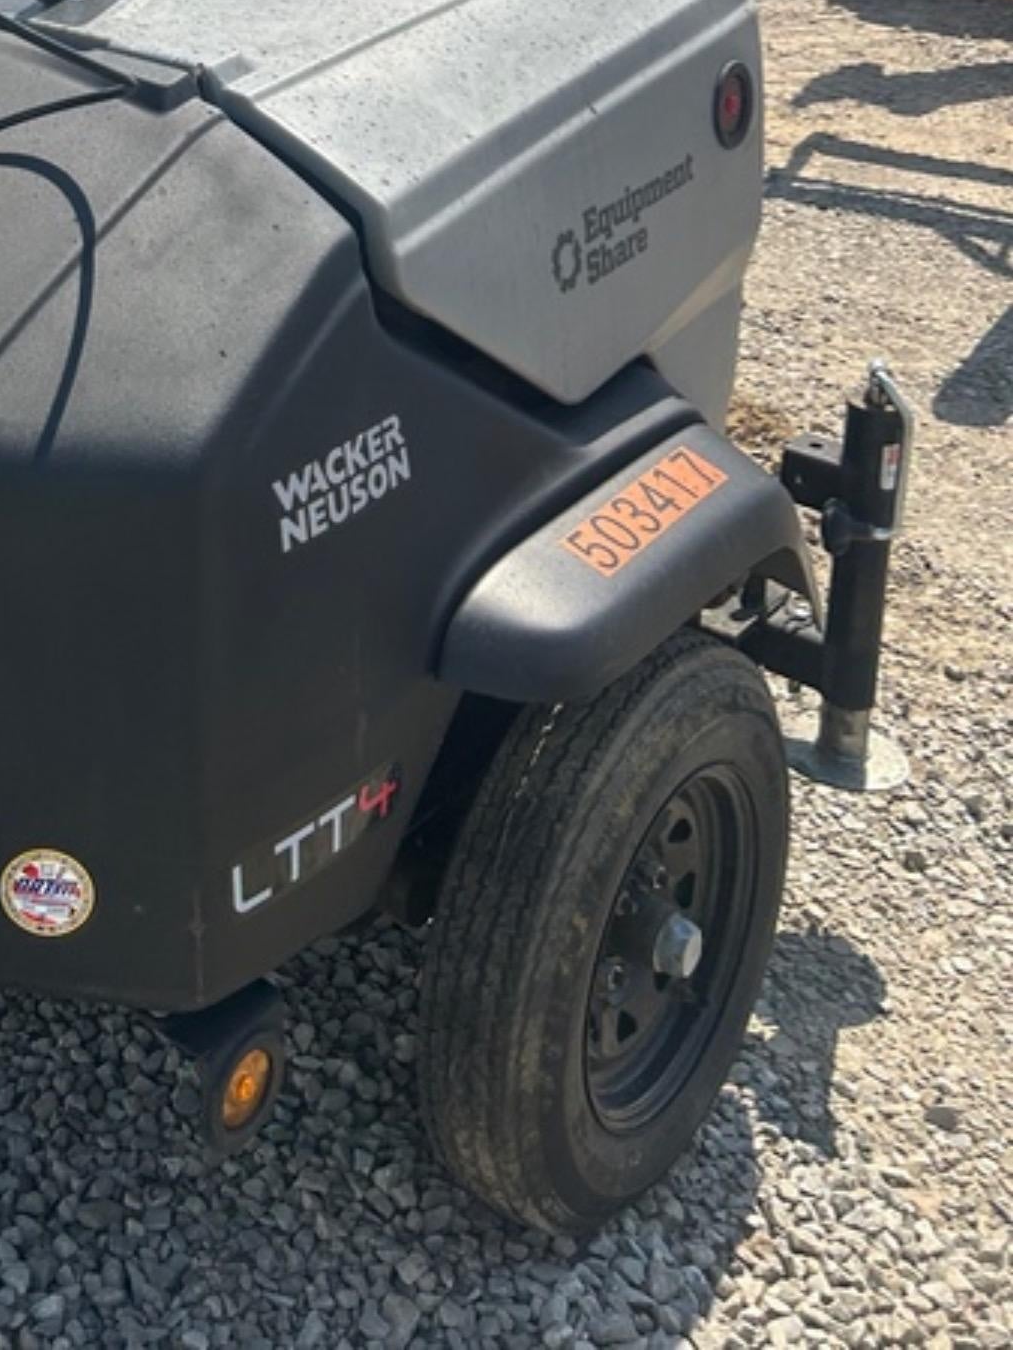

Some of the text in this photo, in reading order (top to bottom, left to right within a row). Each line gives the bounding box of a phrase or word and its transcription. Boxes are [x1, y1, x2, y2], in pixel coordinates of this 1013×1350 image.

[582, 153, 694, 244] Equipment
[586, 227, 648, 285] Share
[271, 413, 405, 512] WACKER
[279, 446, 412, 553] NEUSON
[566, 449, 715, 569] 503417
